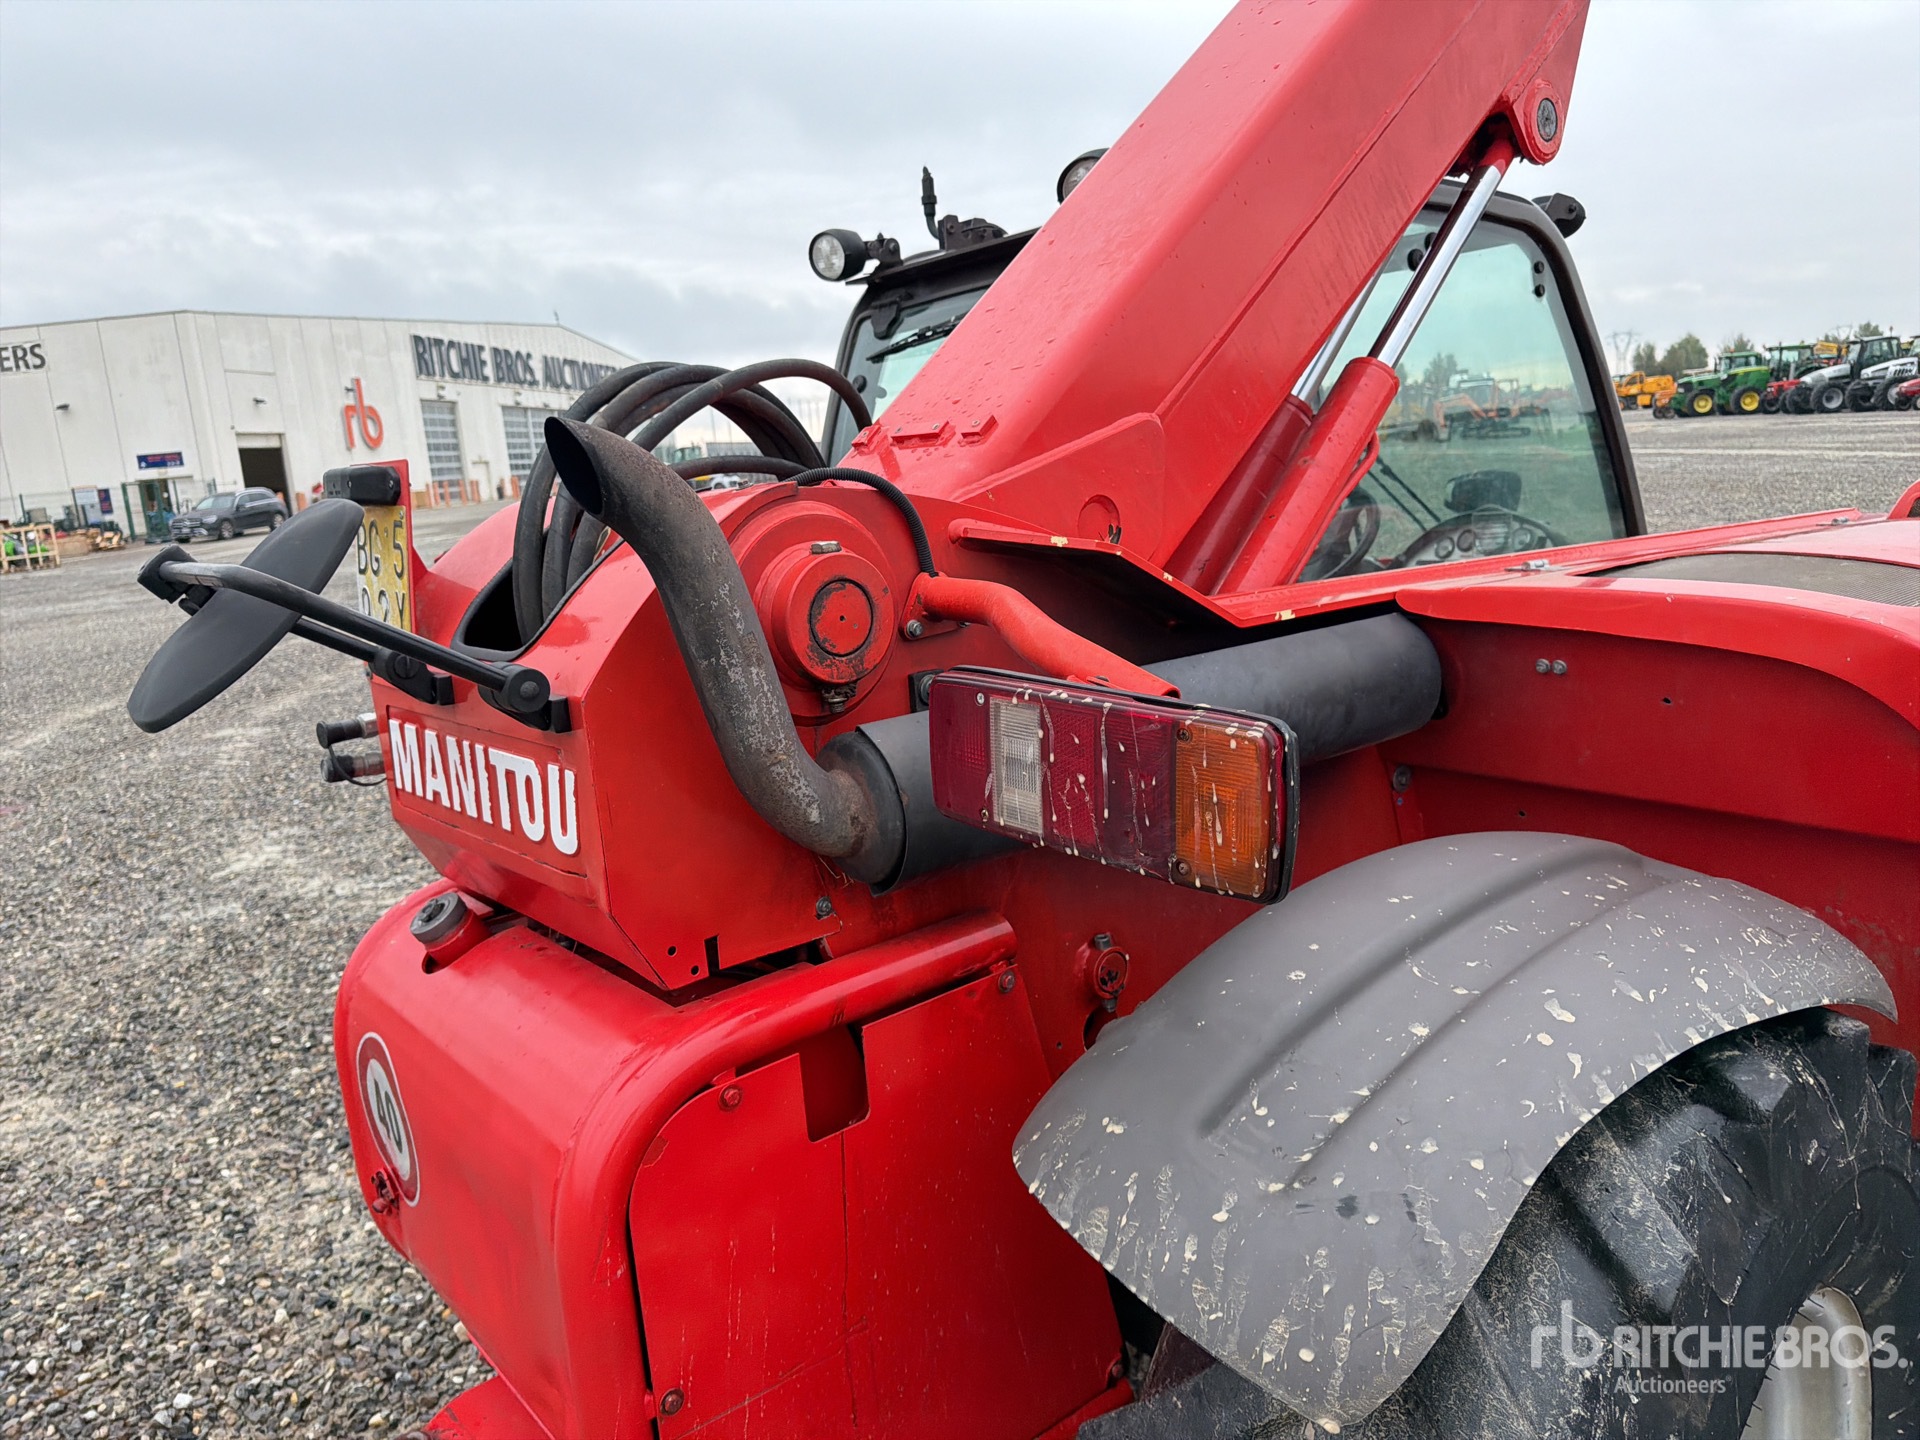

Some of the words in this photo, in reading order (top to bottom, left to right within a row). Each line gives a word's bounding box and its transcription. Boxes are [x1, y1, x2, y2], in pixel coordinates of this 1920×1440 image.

[410, 334, 489, 383] RITCHIE
[490, 346, 539, 387] BROS.
[388, 718, 579, 856] MANITOU
[373, 1078, 403, 1154] 40
